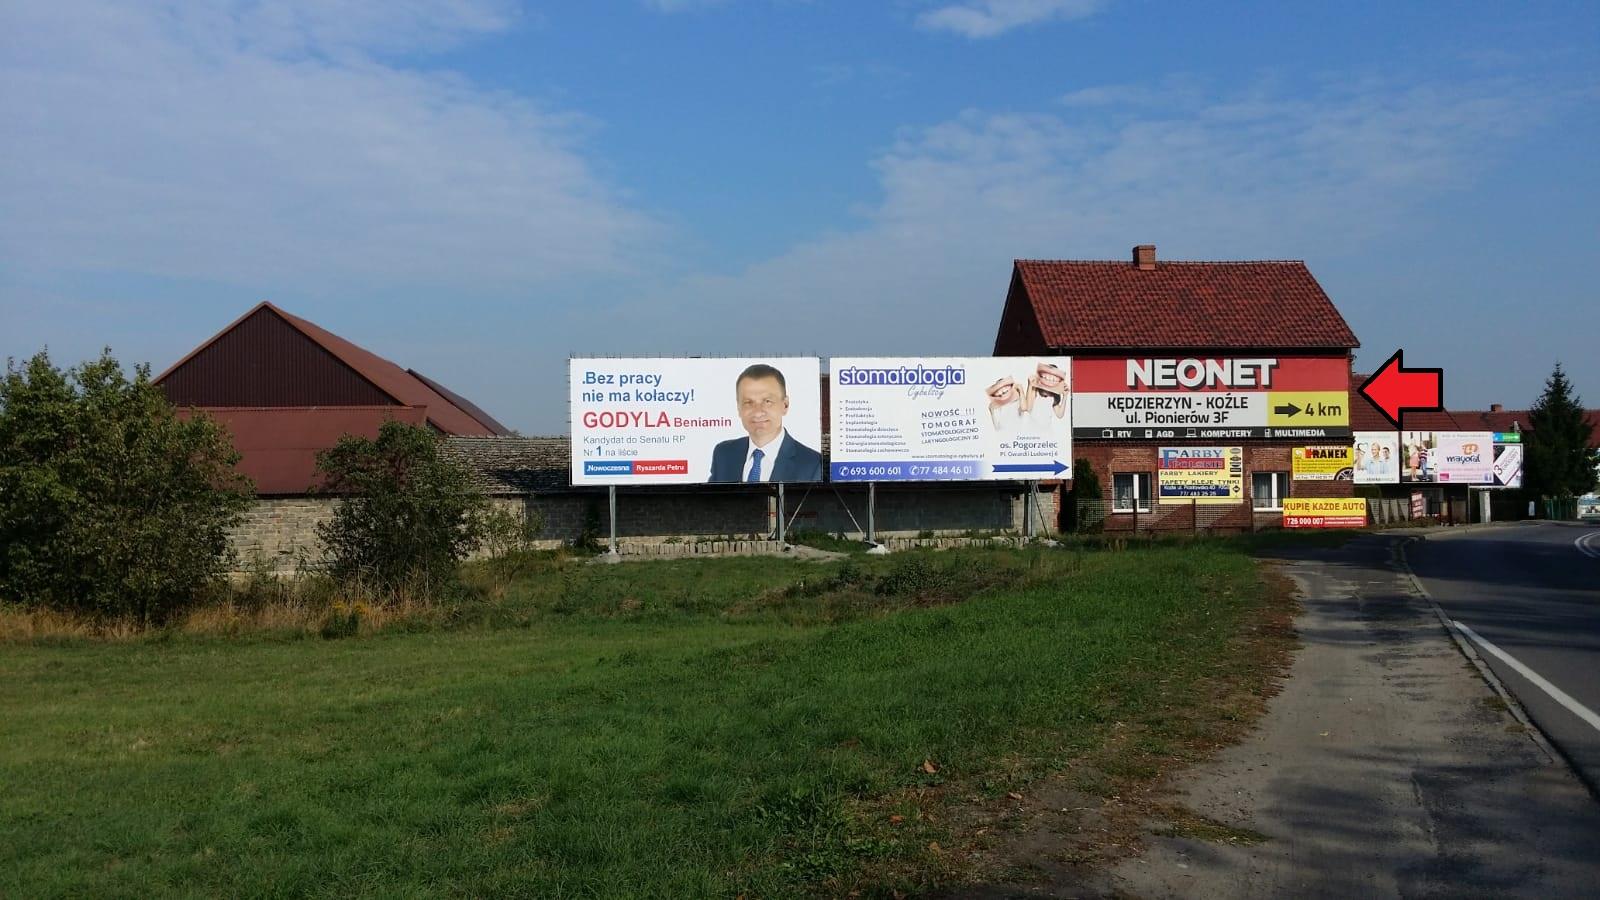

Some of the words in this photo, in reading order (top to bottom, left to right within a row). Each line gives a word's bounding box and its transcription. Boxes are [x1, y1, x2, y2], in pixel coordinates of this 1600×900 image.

[840, 364, 965, 389] stomatologia
[1126, 359, 1277, 387] NEONET
[619, 374, 662, 387] pracy
[583, 391, 604, 401] nie
[609, 392, 630, 401] ma
[636, 389, 694, 404] kołaczy!
[1108, 397, 1191, 412] KĘDZIERZYN
[1207, 394, 1248, 409] KOŹLE
[922, 409, 960, 418] NOWOŚĆ
[1305, 403, 1313, 415] 4
[1319, 403, 1341, 416] km
[584, 412, 670, 427] GODYLA
[674, 417, 731, 427] Beniamin
[1126, 412, 1141, 424] ul.
[1146, 411, 1209, 424] Pionierów
[1213, 412, 1229, 423] 3F
[922, 419, 976, 429] TOMOGRAF
[1118, 430, 1131, 438] RTV
[1157, 430, 1174, 438] AGD
[1201, 430, 1252, 438] KOMPUTERY
[1275, 429, 1325, 437] MULTIMEDIA
[584, 436, 624, 445] Kandydat
[627, 436, 636, 444] do
[640, 436, 669, 444] Senatu
[672, 435, 686, 443] RP
[1013, 441, 1057, 450] Pogorzelec
[596, 446, 602, 456] 1
[1162, 450, 1222, 469] FARBY
[1447, 454, 1480, 464] mayoral
[636, 464, 665, 472] Ryszarda
[851, 467, 866, 475] 693
[869, 467, 884, 475] 600
[888, 467, 901, 475] 601
